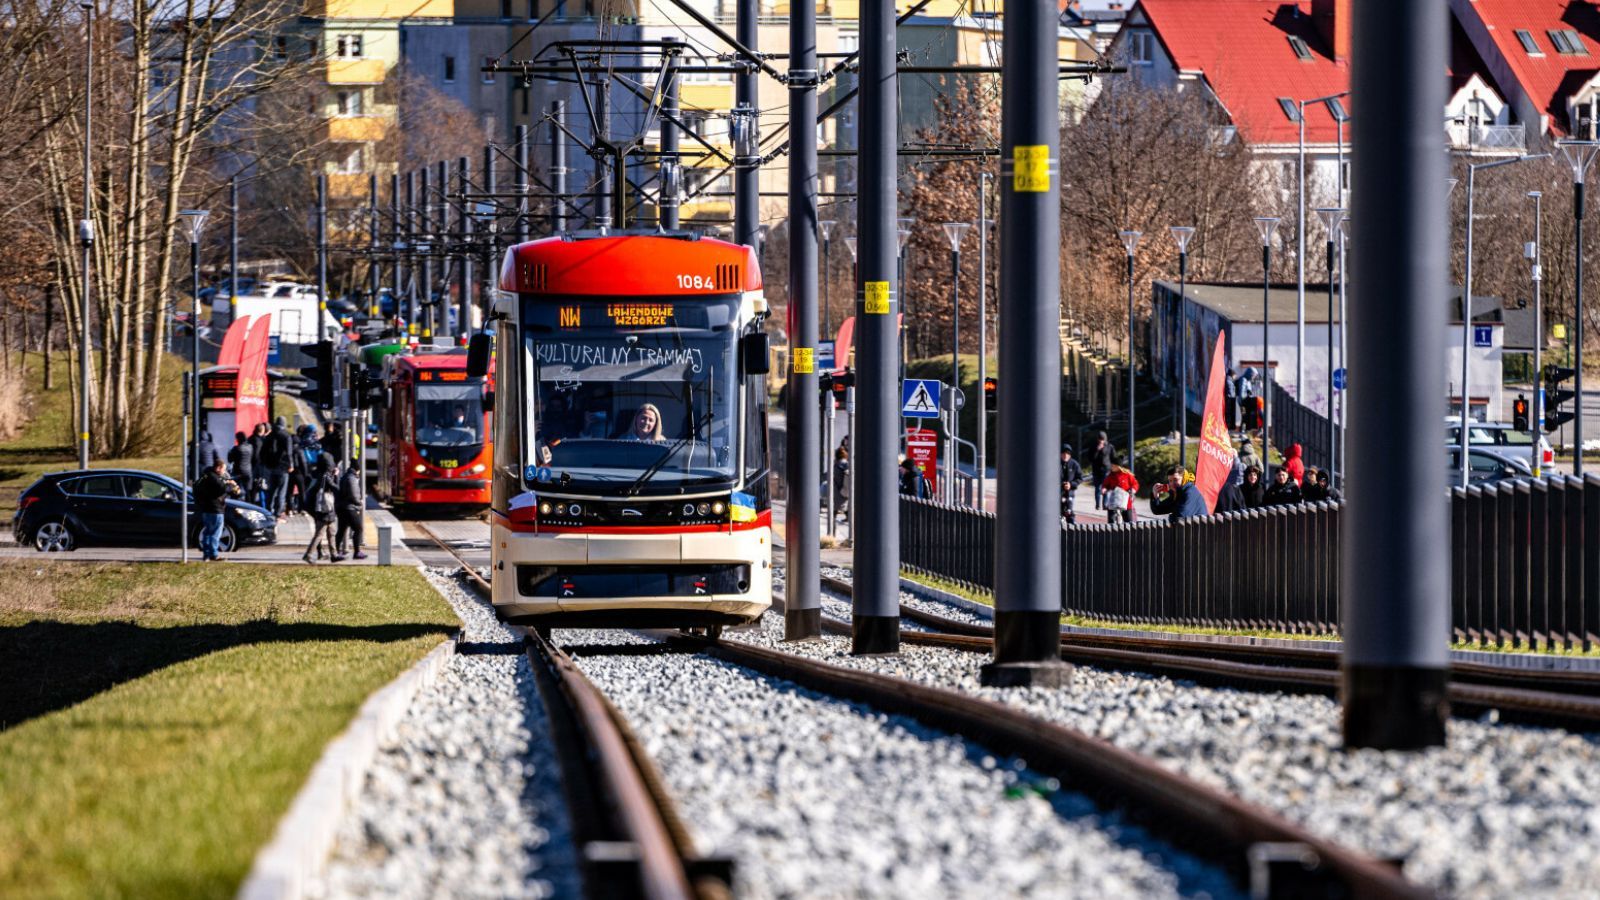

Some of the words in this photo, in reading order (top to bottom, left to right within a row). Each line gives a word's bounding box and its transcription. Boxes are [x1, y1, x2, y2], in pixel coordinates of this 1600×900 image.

[677, 274, 714, 290] 1084
[560, 306, 581, 327] NW
[607, 307, 674, 317] LAWENDOWE
[536, 342, 631, 366] KULTURALNY
[635, 347, 703, 373] TRAMWAJ
